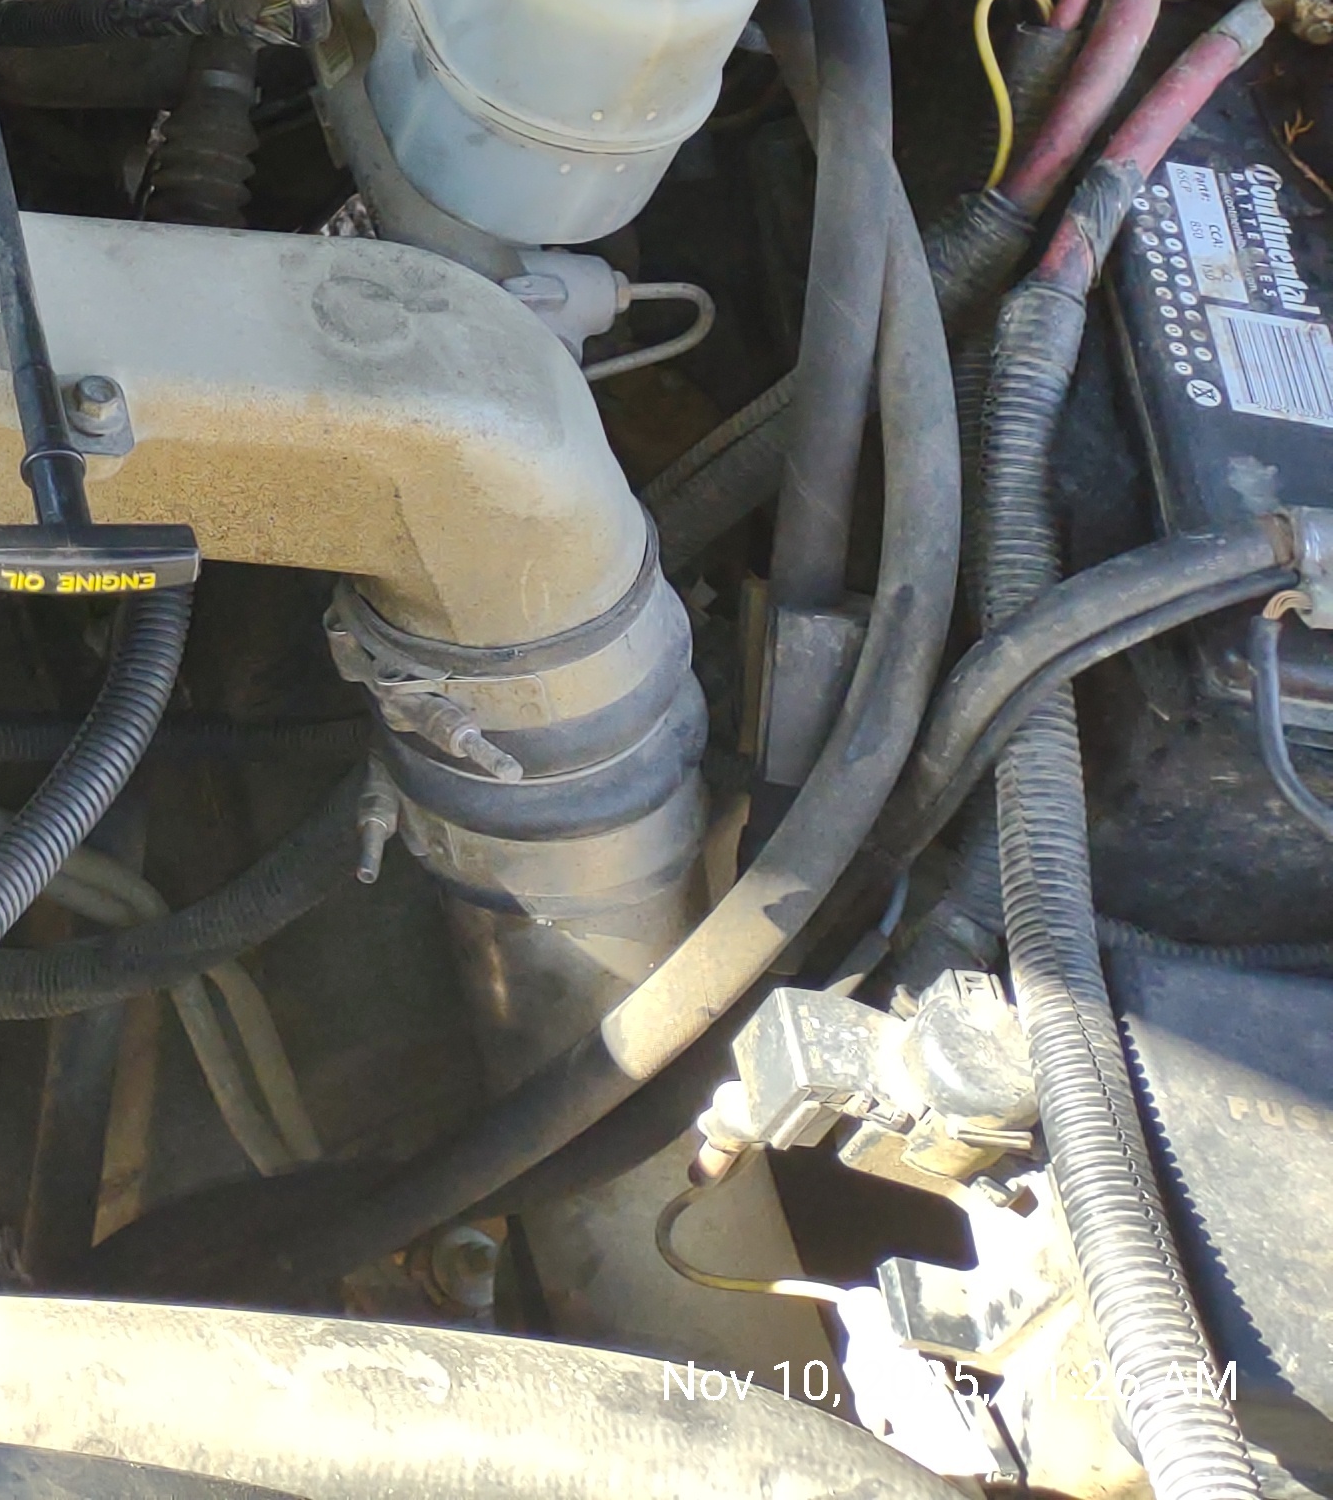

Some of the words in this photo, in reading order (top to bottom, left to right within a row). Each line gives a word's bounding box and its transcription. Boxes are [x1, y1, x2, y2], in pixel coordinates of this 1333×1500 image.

[1189, 220, 1205, 240] 850
[1208, 223, 1224, 250] CCA:
[1244, 163, 1322, 315] Continental
[0, 569, 46, 593] OIL
[56, 570, 158, 594] ENGINE
[1225, 1093, 1333, 1140] FUS
